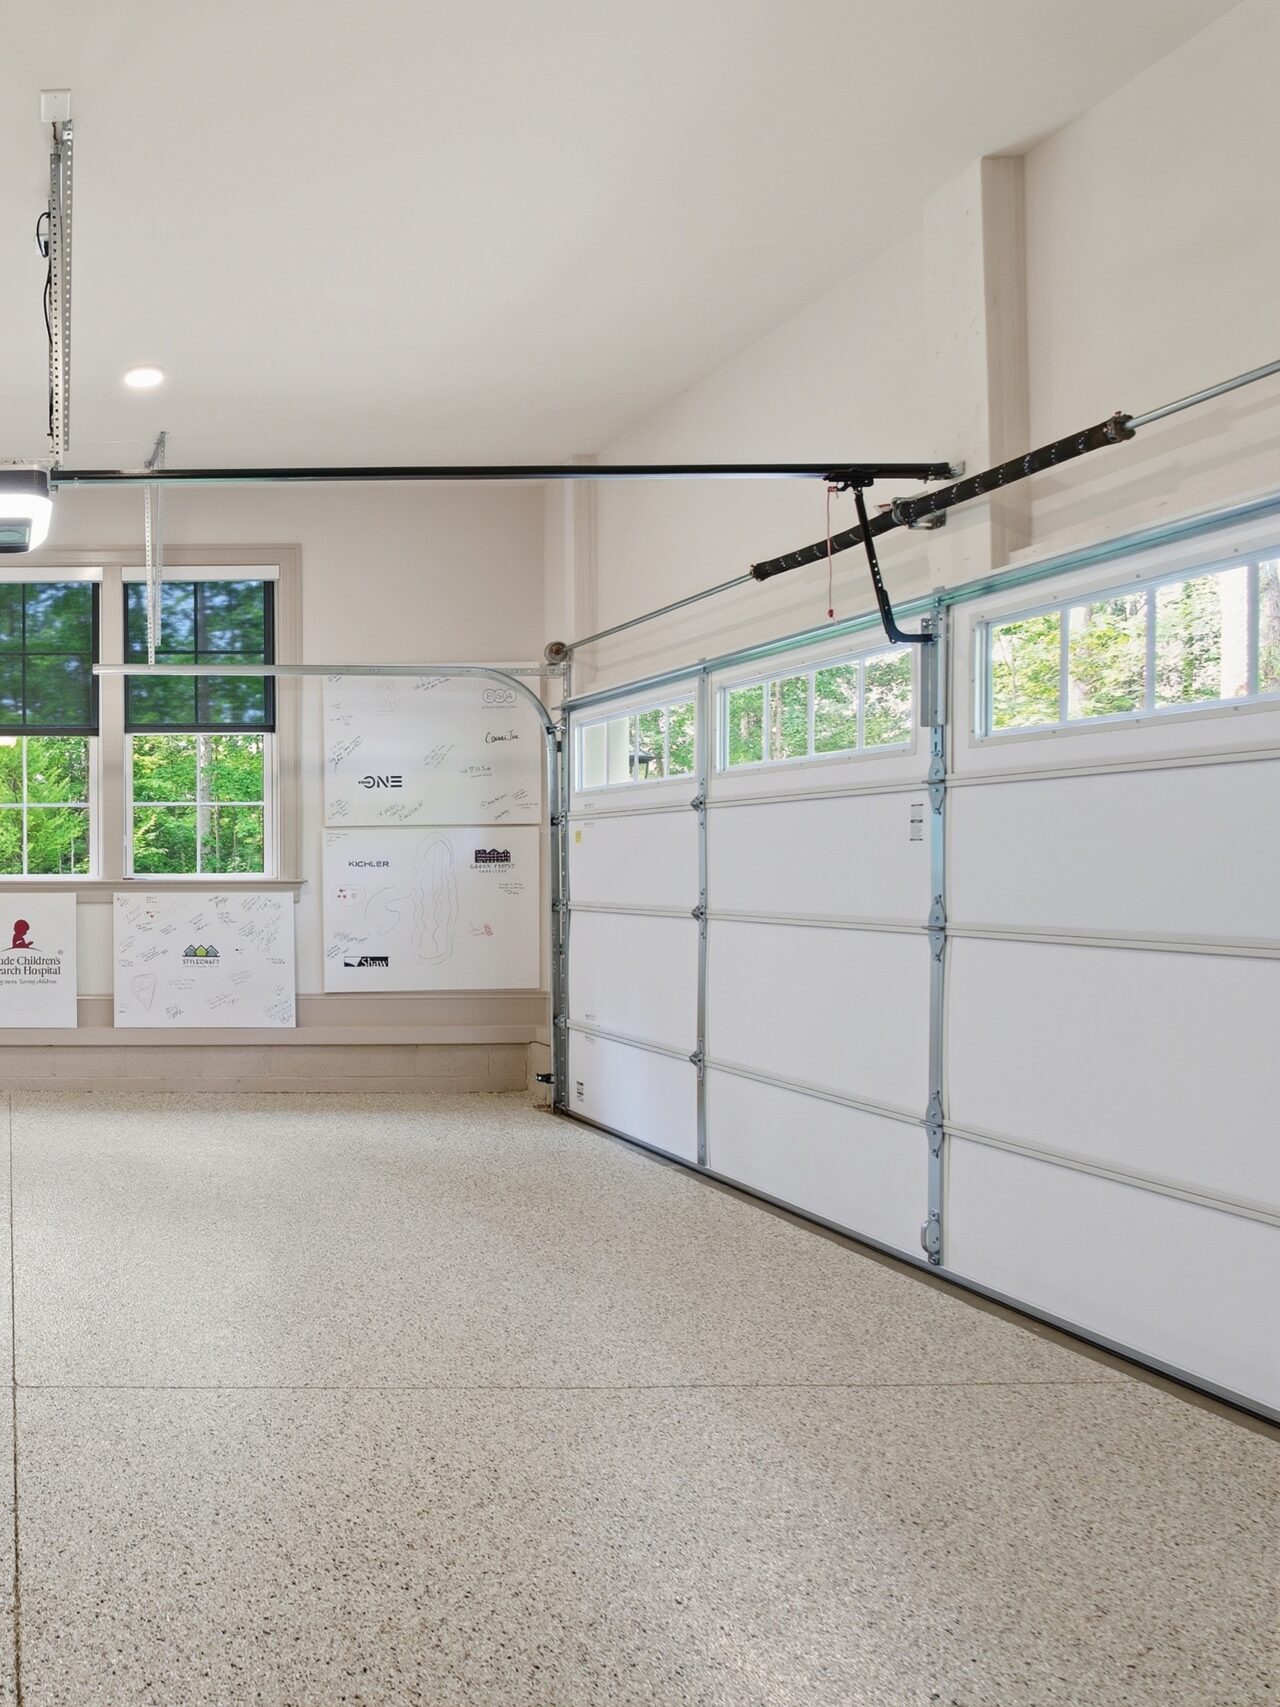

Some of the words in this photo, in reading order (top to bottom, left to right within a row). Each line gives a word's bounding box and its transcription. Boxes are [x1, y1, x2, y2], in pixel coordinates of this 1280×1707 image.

[16, 956, 60, 965] Children's
[361, 957, 388, 967] Shaw
[24, 966, 61, 977] Hospital
